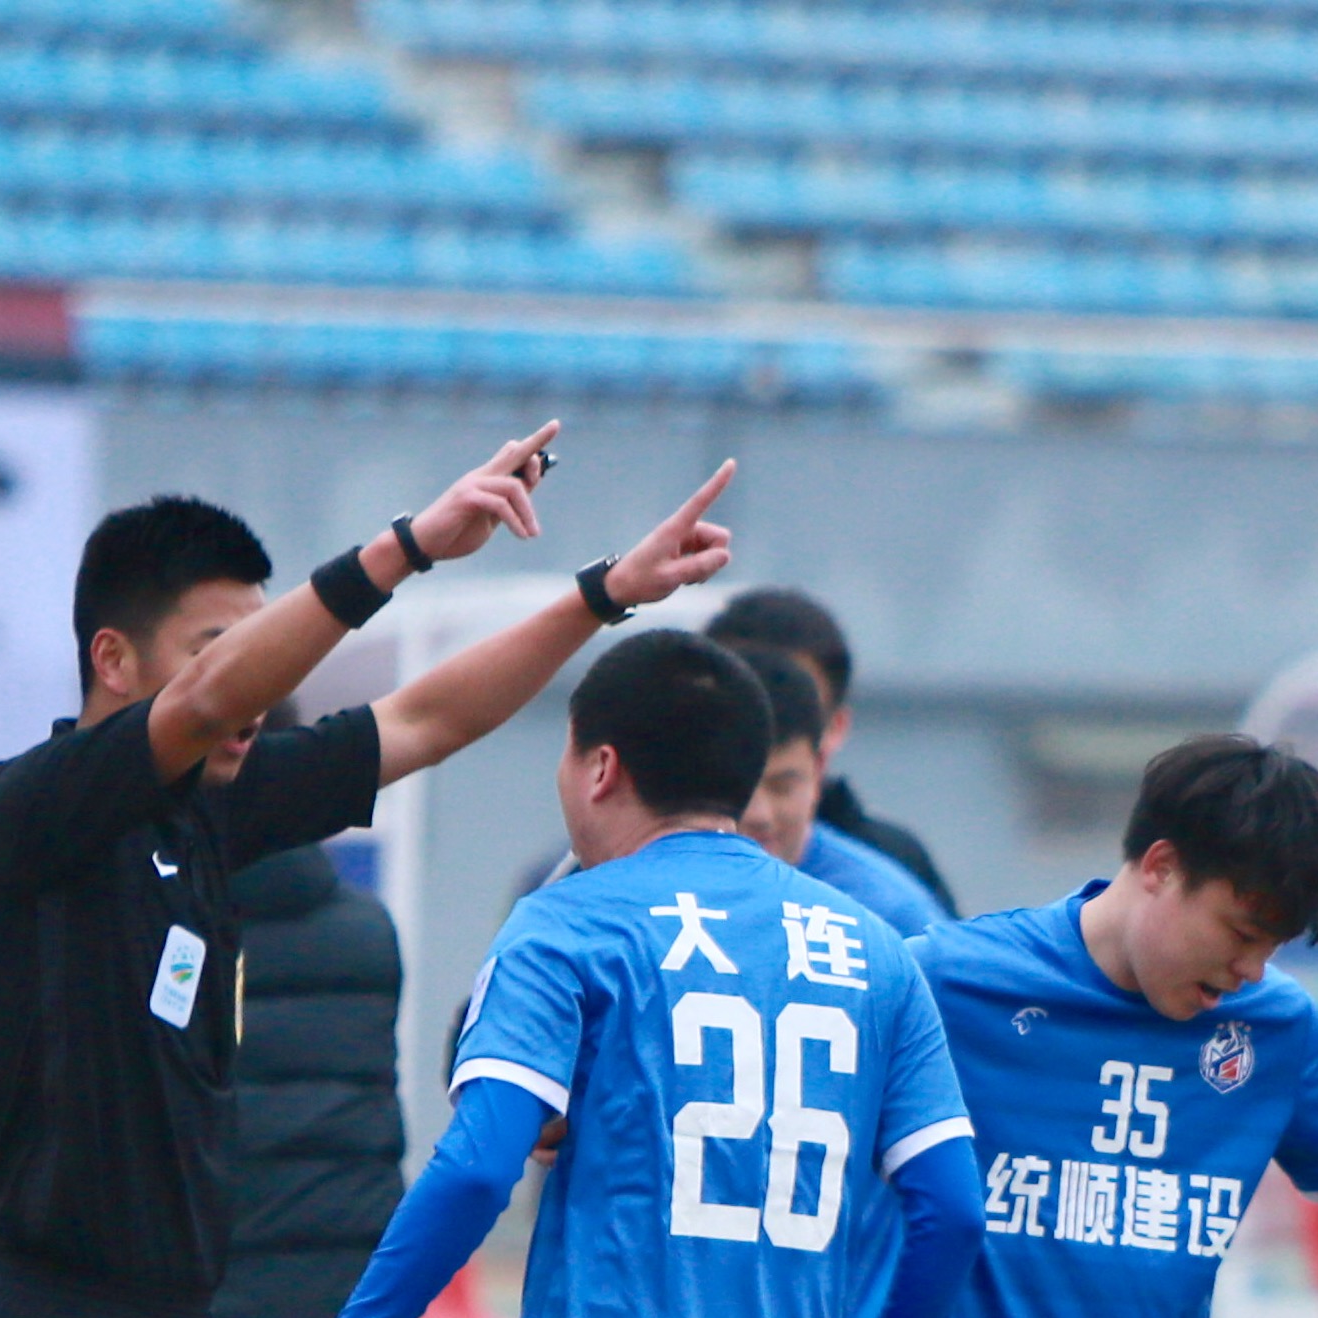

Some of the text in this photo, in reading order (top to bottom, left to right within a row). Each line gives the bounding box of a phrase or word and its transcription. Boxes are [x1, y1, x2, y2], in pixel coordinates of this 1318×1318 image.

[649, 891, 869, 990] 大连
[670, 991, 858, 1252] 26
[1091, 1059, 1173, 1159] 35
[984, 1151, 1244, 1259] 统顺建设
